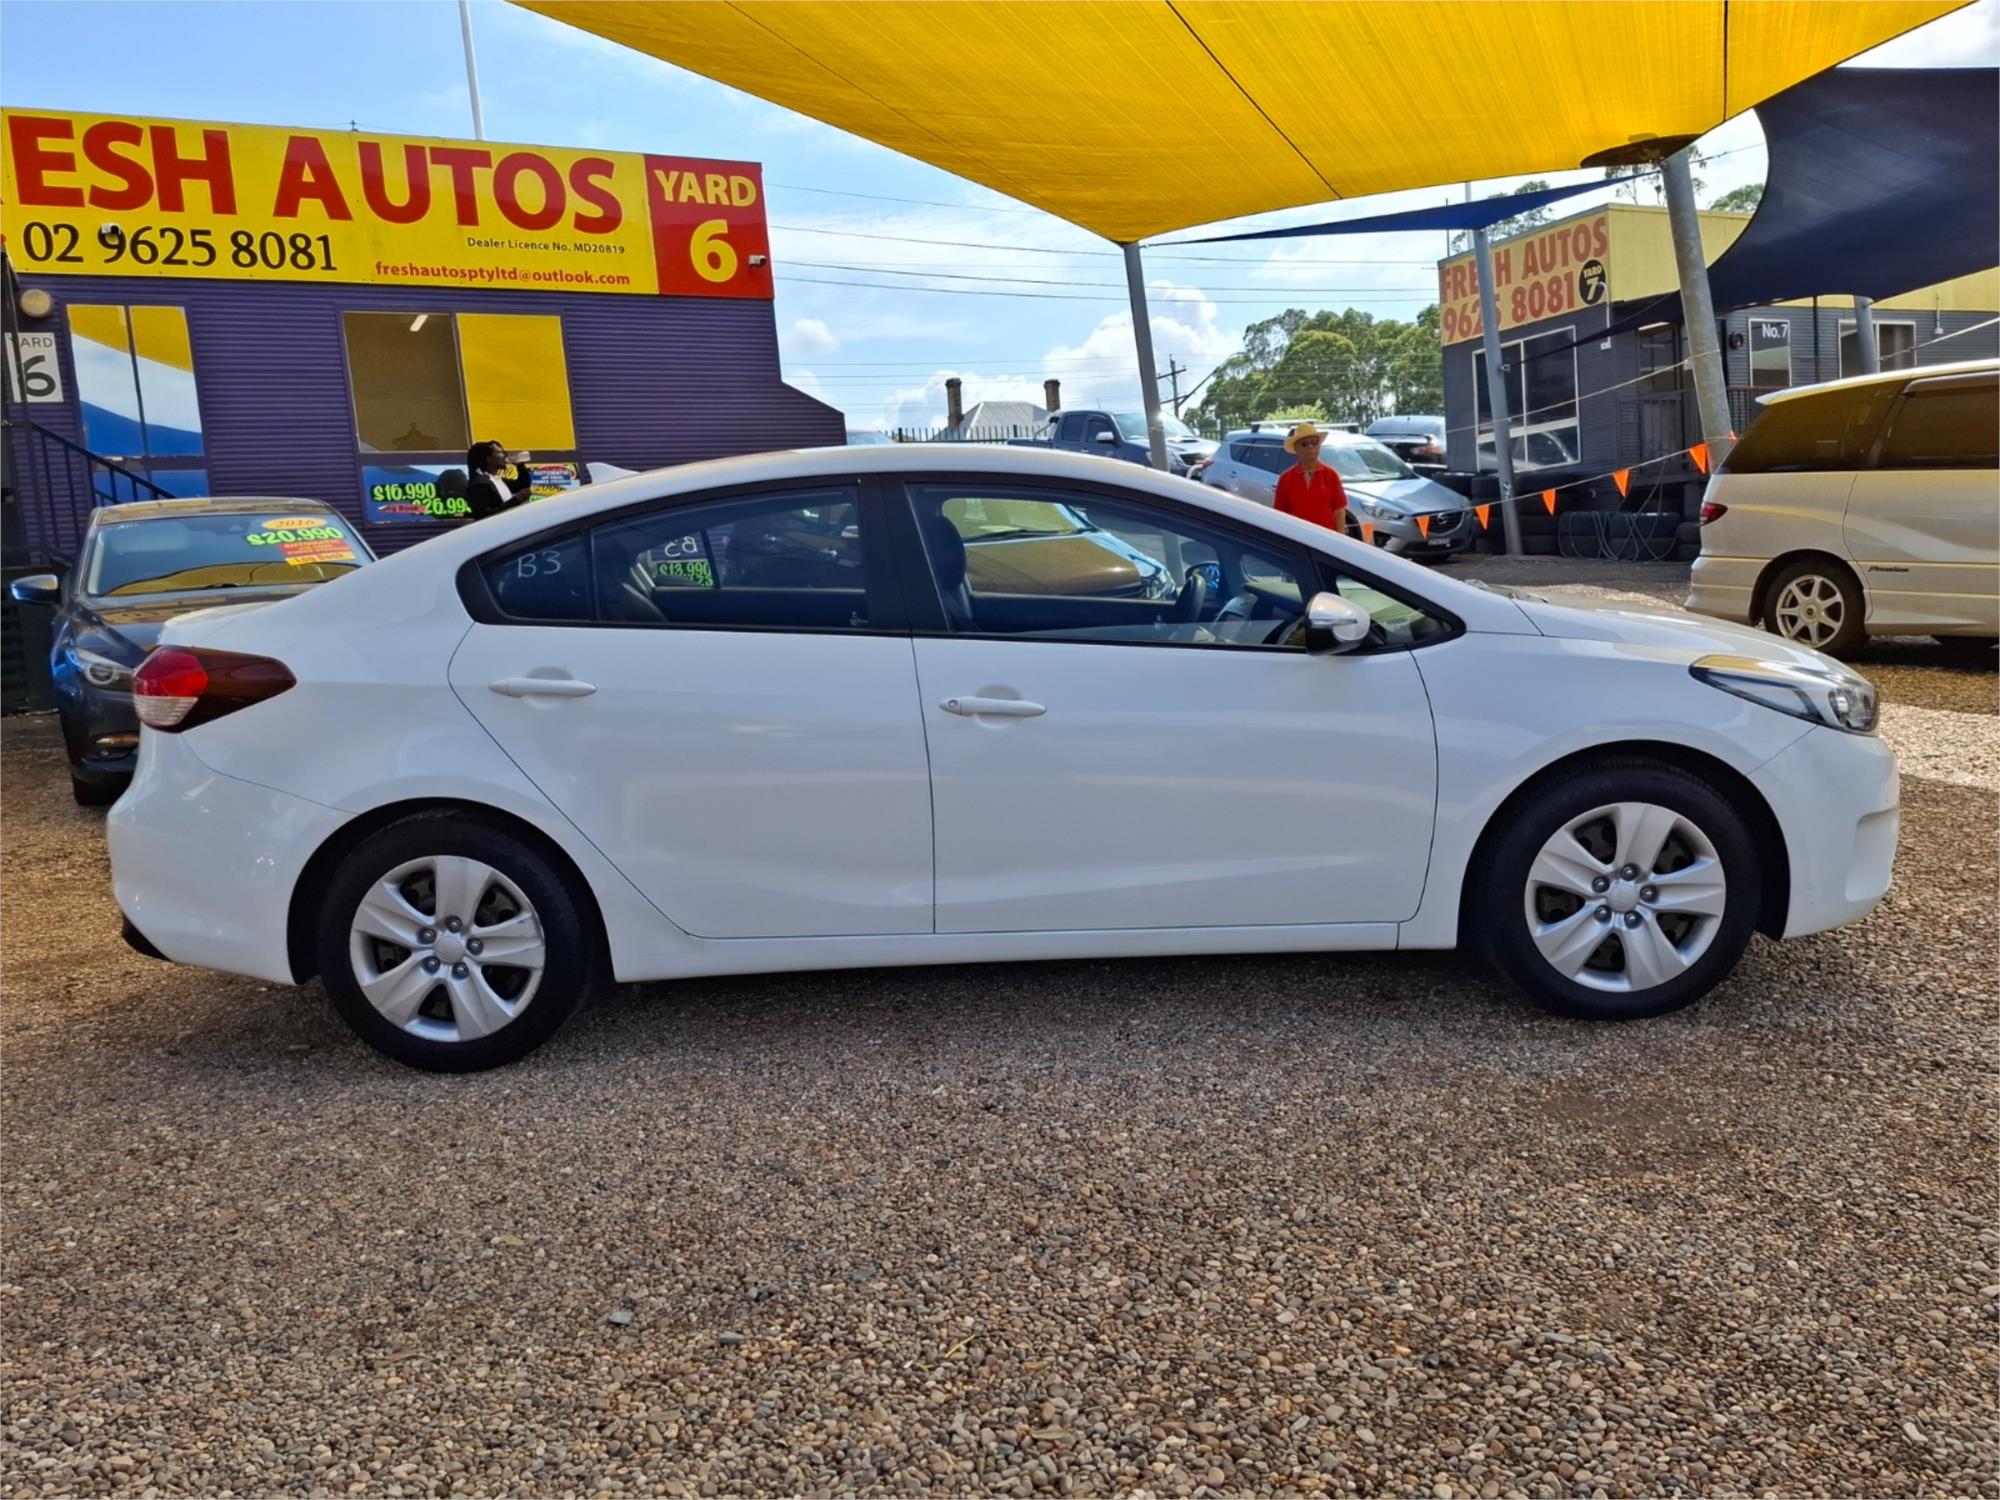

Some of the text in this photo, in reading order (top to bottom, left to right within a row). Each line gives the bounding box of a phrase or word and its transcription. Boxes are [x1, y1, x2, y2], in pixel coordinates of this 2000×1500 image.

[0, 115, 624, 234] ESH AUTOS
[653, 169, 757, 207] YARD
[23, 221, 338, 271] 02 9625 8081
[467, 237, 625, 254] Dealer Licence No. MD20819
[689, 219, 738, 283] 6
[375, 261, 631, 286] freshautosptyltd@outlook.com
[1441, 216, 1608, 304] FREH AUTOS
[1583, 265, 1602, 279] YARD
[1512, 270, 1575, 324] 8081
[1586, 276, 1602, 301] 7
[9, 337, 53, 348] ARD
[24, 355, 56, 397] 6
[373, 482, 436, 501] $16.990
[247, 527, 344, 546] $20.990
[517, 551, 561, 578] B3
